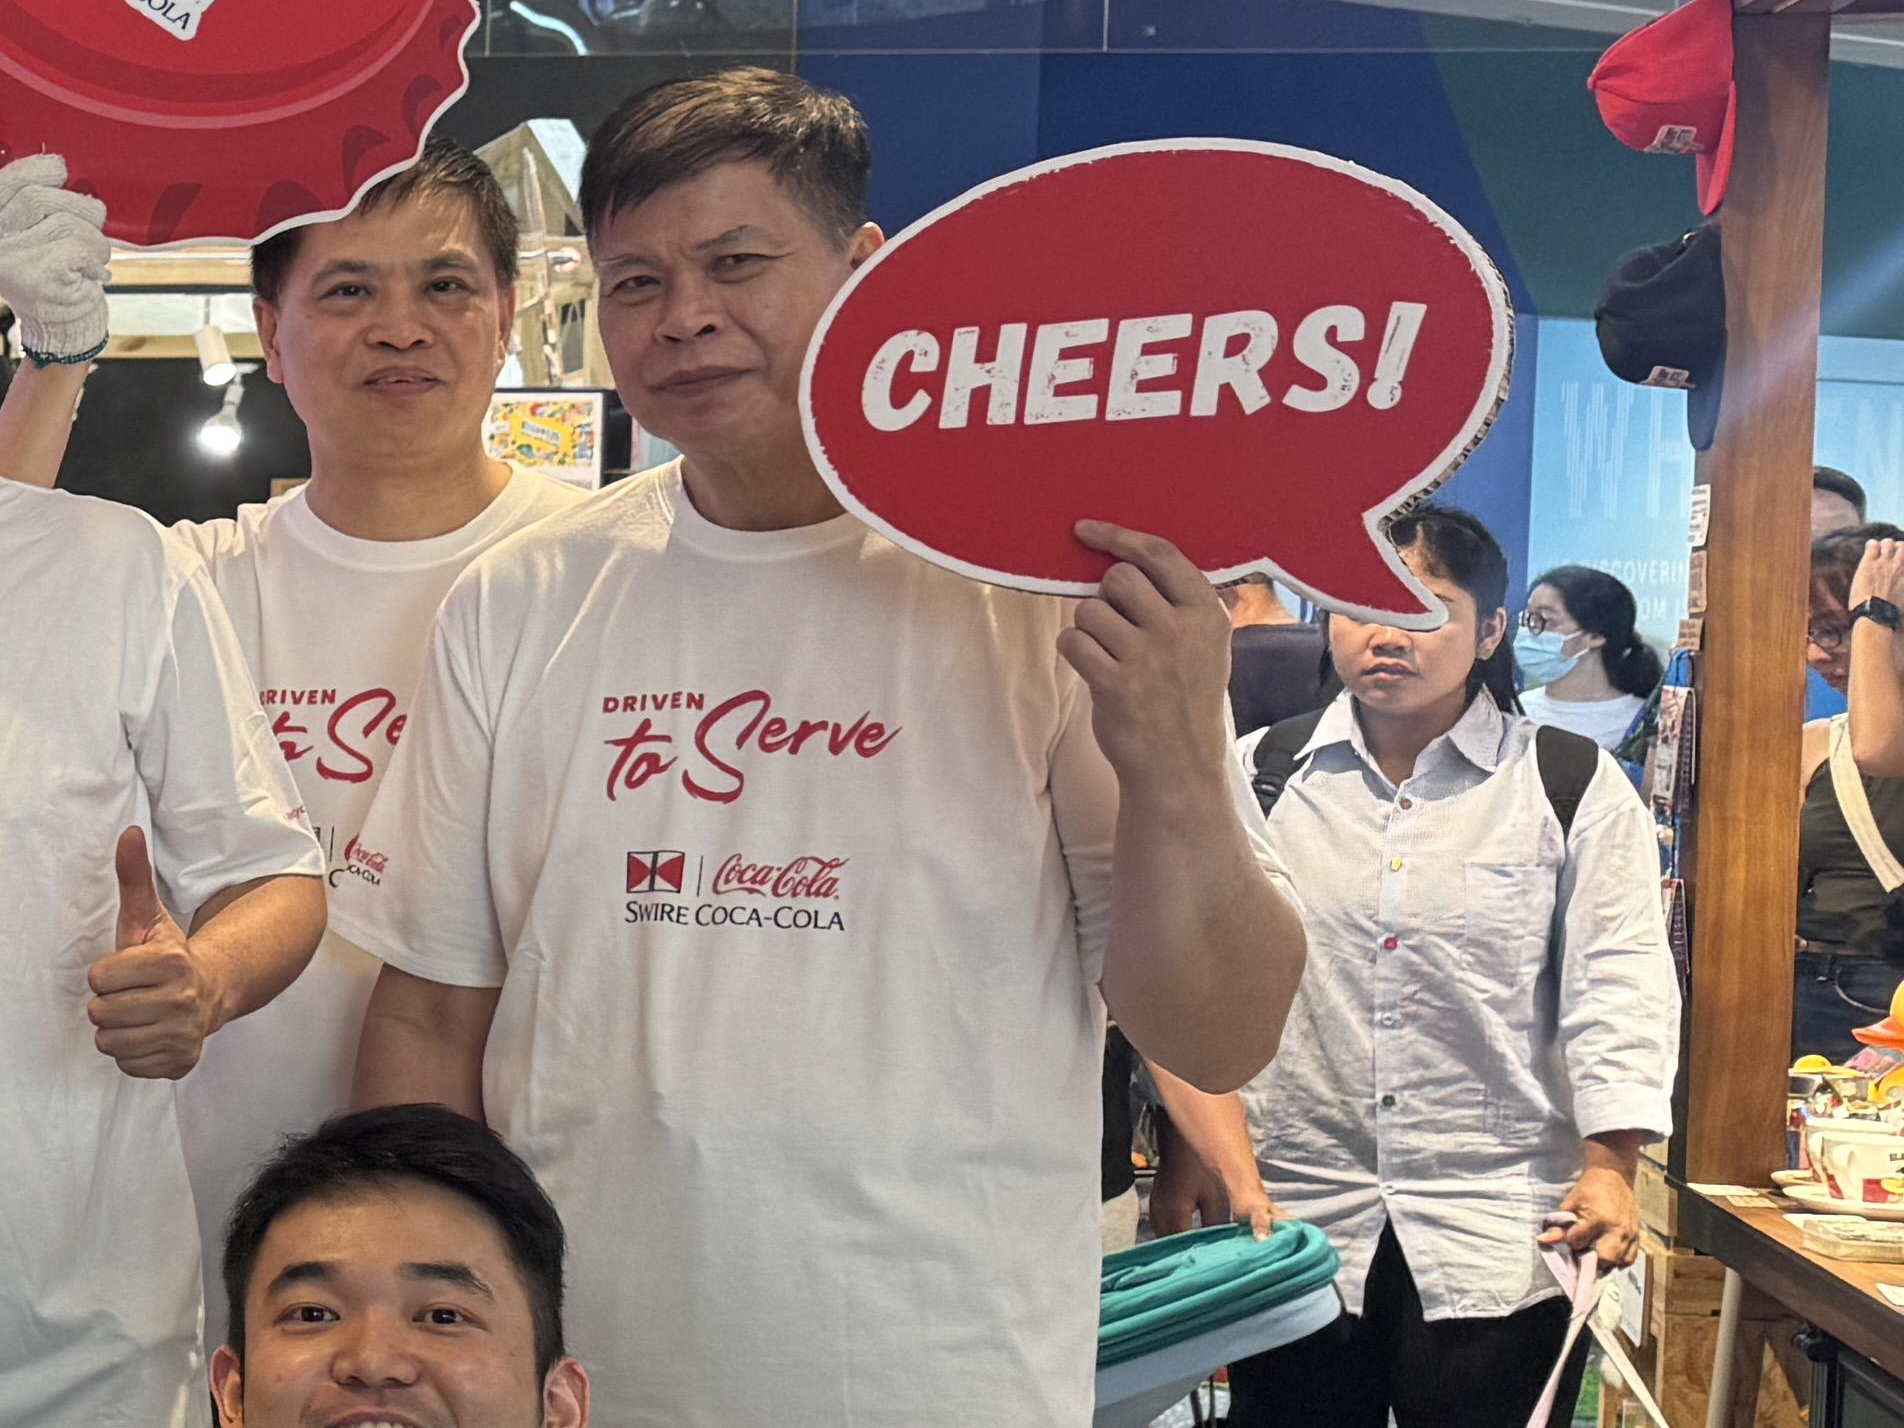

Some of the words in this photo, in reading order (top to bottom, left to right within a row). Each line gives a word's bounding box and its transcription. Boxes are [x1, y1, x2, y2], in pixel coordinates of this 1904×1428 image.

[860, 300, 1428, 432] CHEERS!
[603, 691, 705, 714] DRIVEN
[604, 718, 678, 802] to
[682, 689, 903, 804] Serve
[712, 853, 850, 901] Coca-Cola
[624, 901, 690, 925] SWIRE
[695, 904, 845, 932] COCA-COLA
